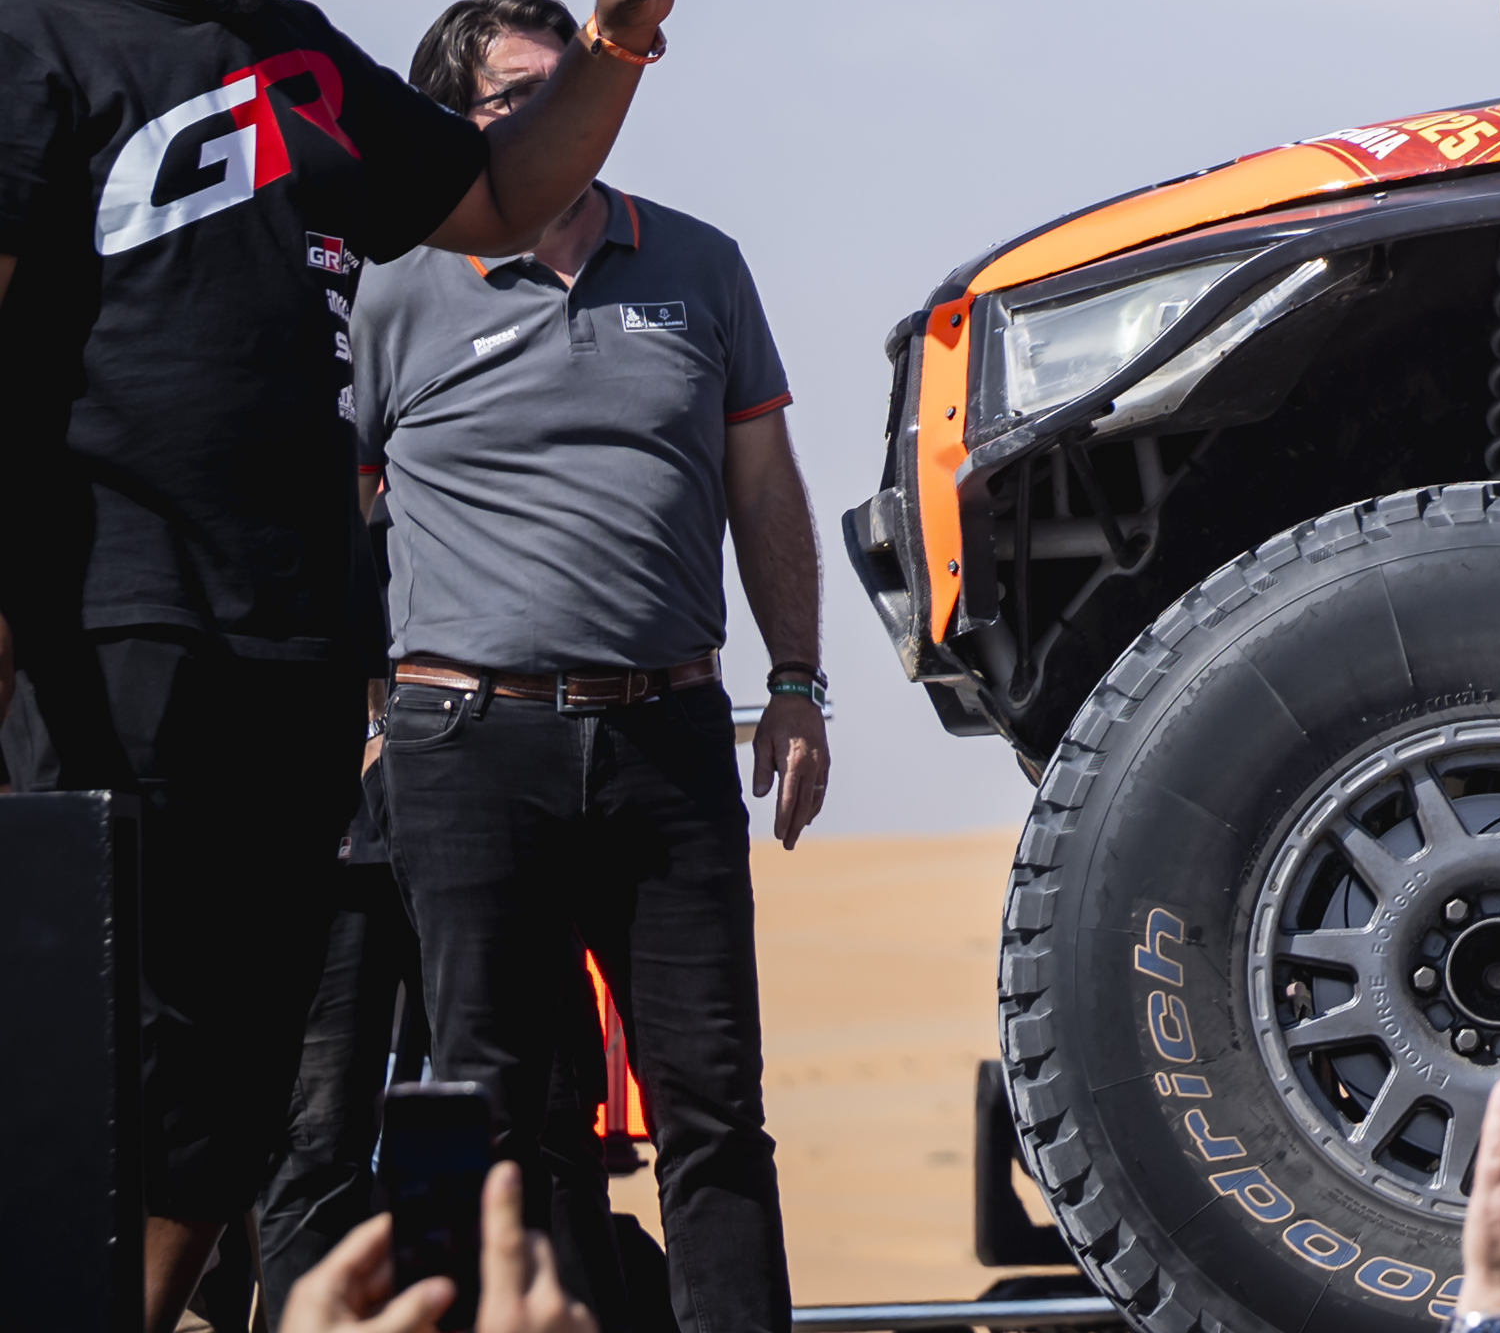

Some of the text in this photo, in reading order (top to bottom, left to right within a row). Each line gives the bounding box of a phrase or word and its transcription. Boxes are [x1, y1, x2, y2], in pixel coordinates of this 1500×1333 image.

[95, 49, 361, 255] GR
[309, 247, 340, 270] GR
[1371, 870, 1450, 1090] EVOCORSE FORGED
